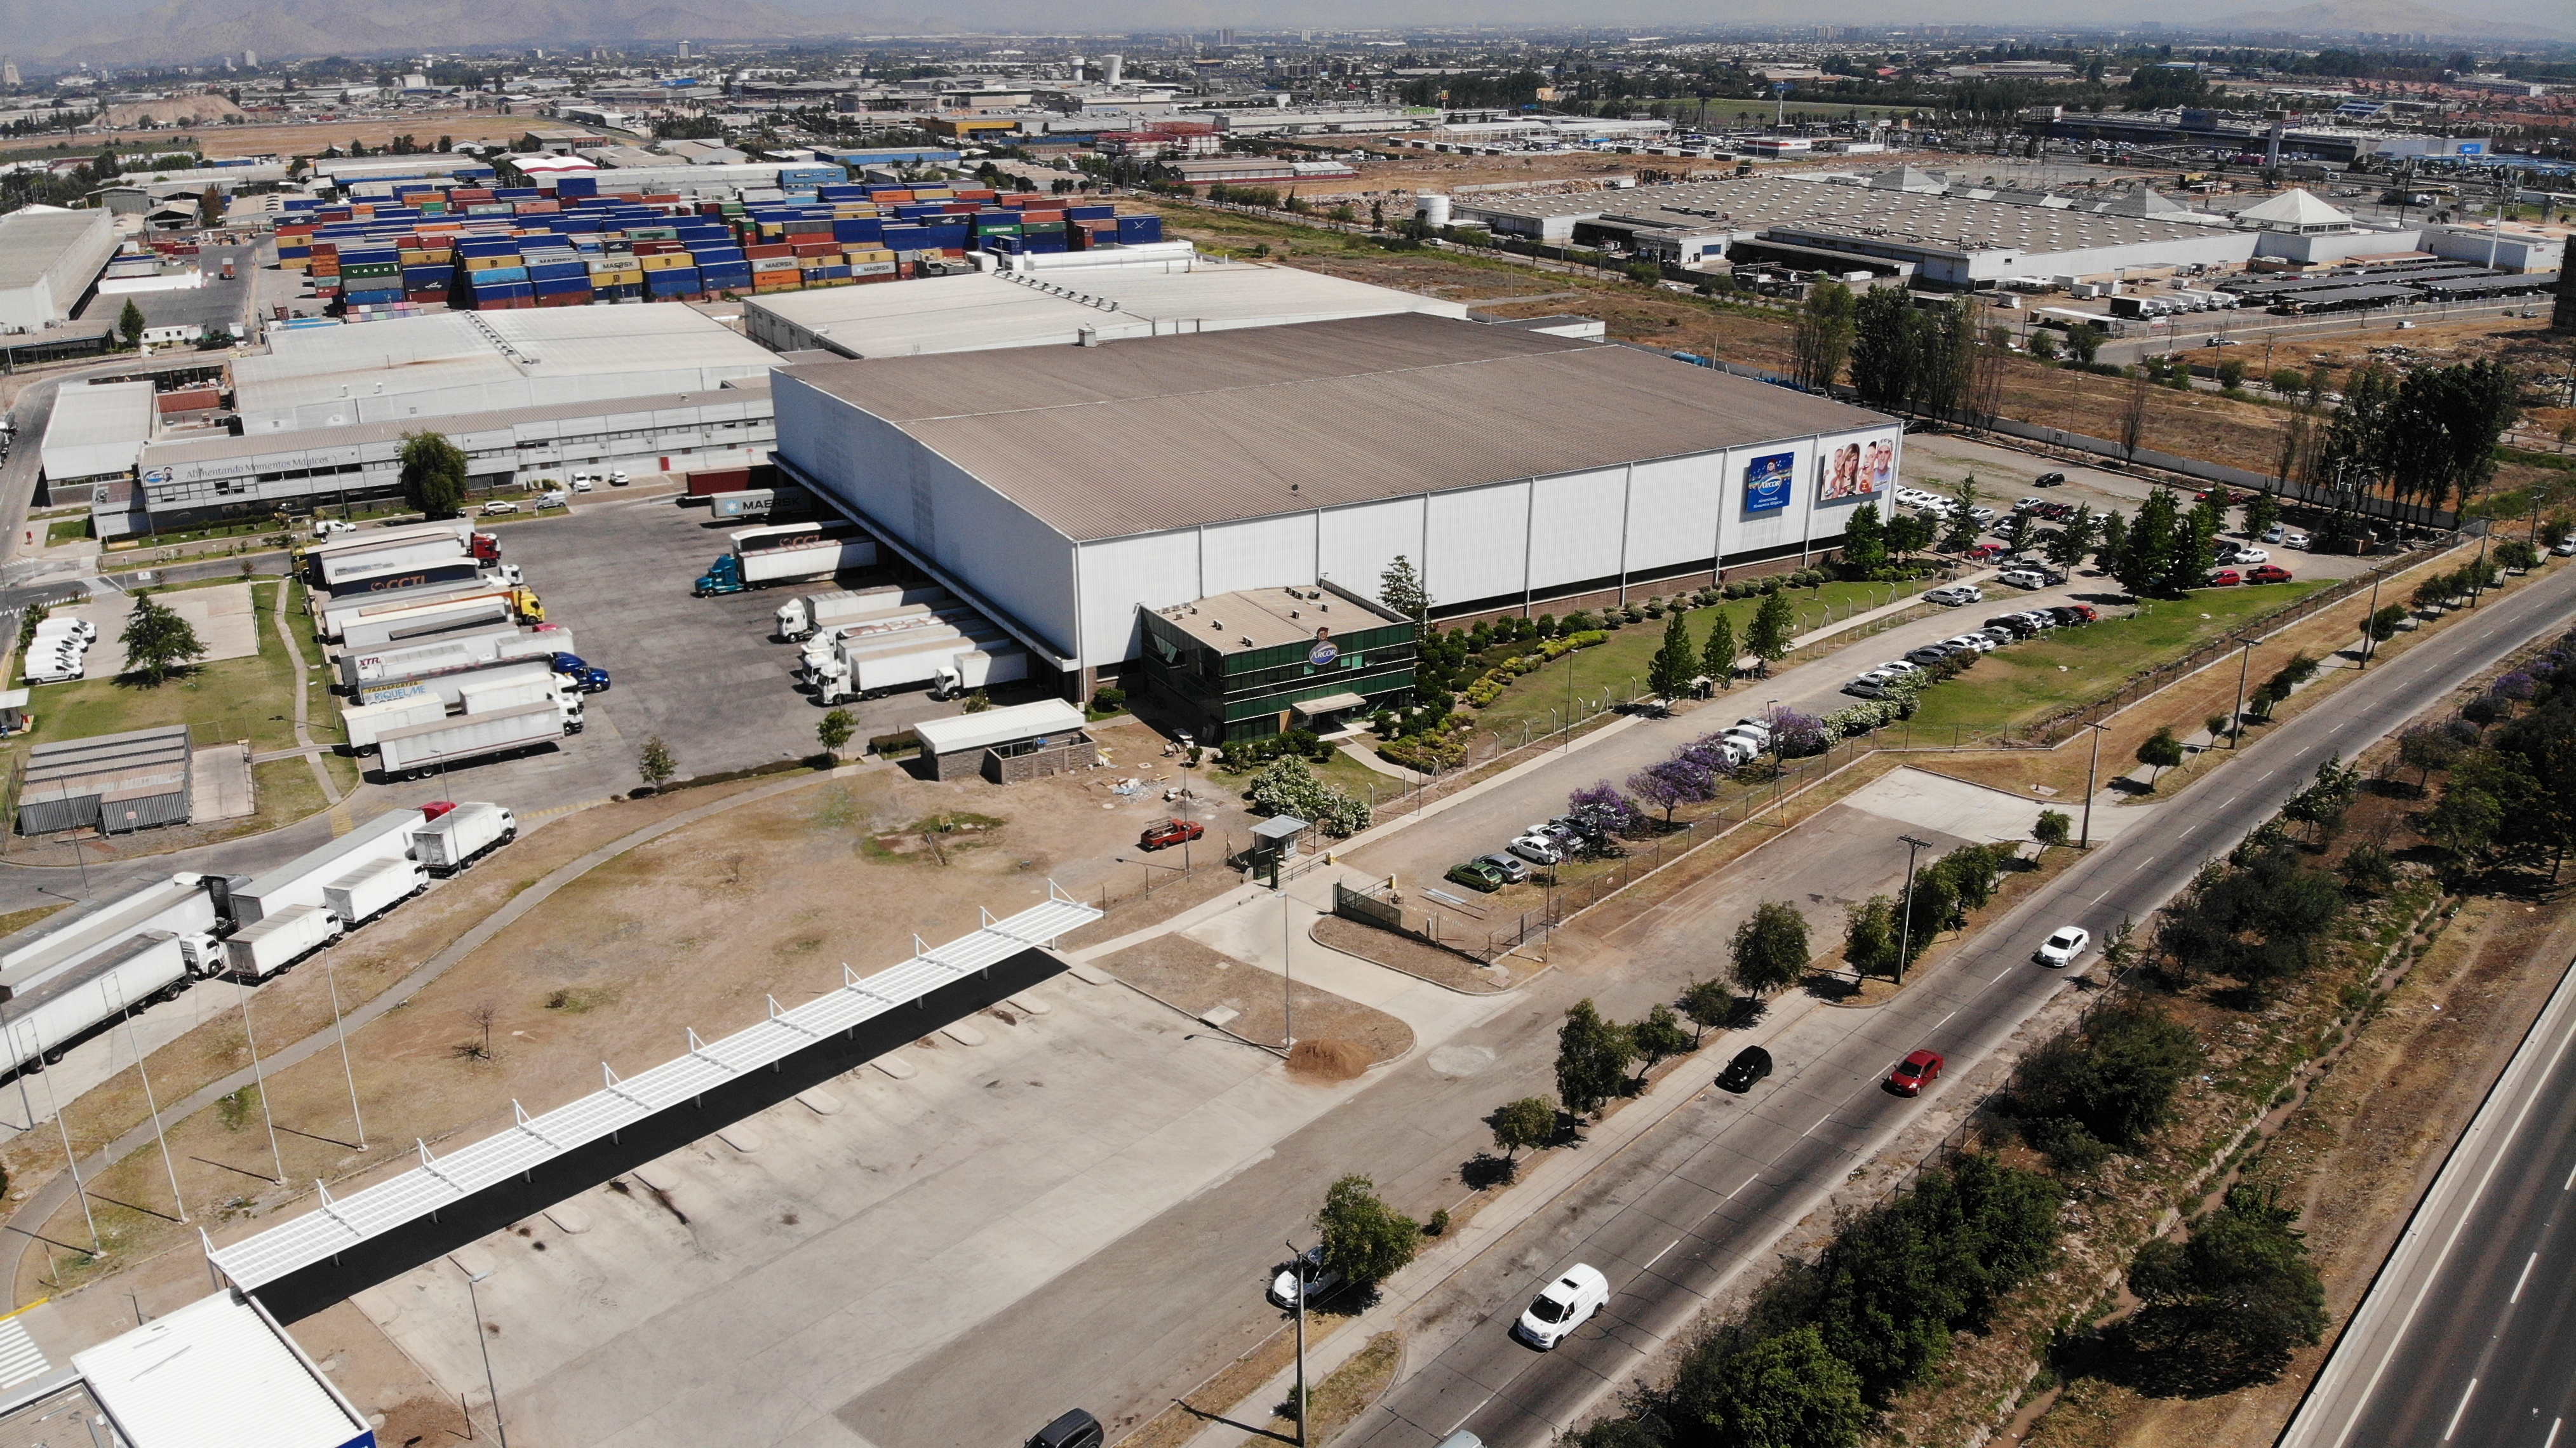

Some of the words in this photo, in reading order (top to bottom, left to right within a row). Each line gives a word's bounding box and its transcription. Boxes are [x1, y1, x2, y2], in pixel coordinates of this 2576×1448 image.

[186, 465, 243, 479] Alimentando
[245, 461, 291, 471] Momentos
[1759, 480, 1781, 488] ARCOR
[742, 497, 800, 511] MAERSK
[1310, 649, 1336, 659] ARCOR
[368, 681, 418, 692] TRANSPORTES
[374, 685, 426, 701] RIQUELME
